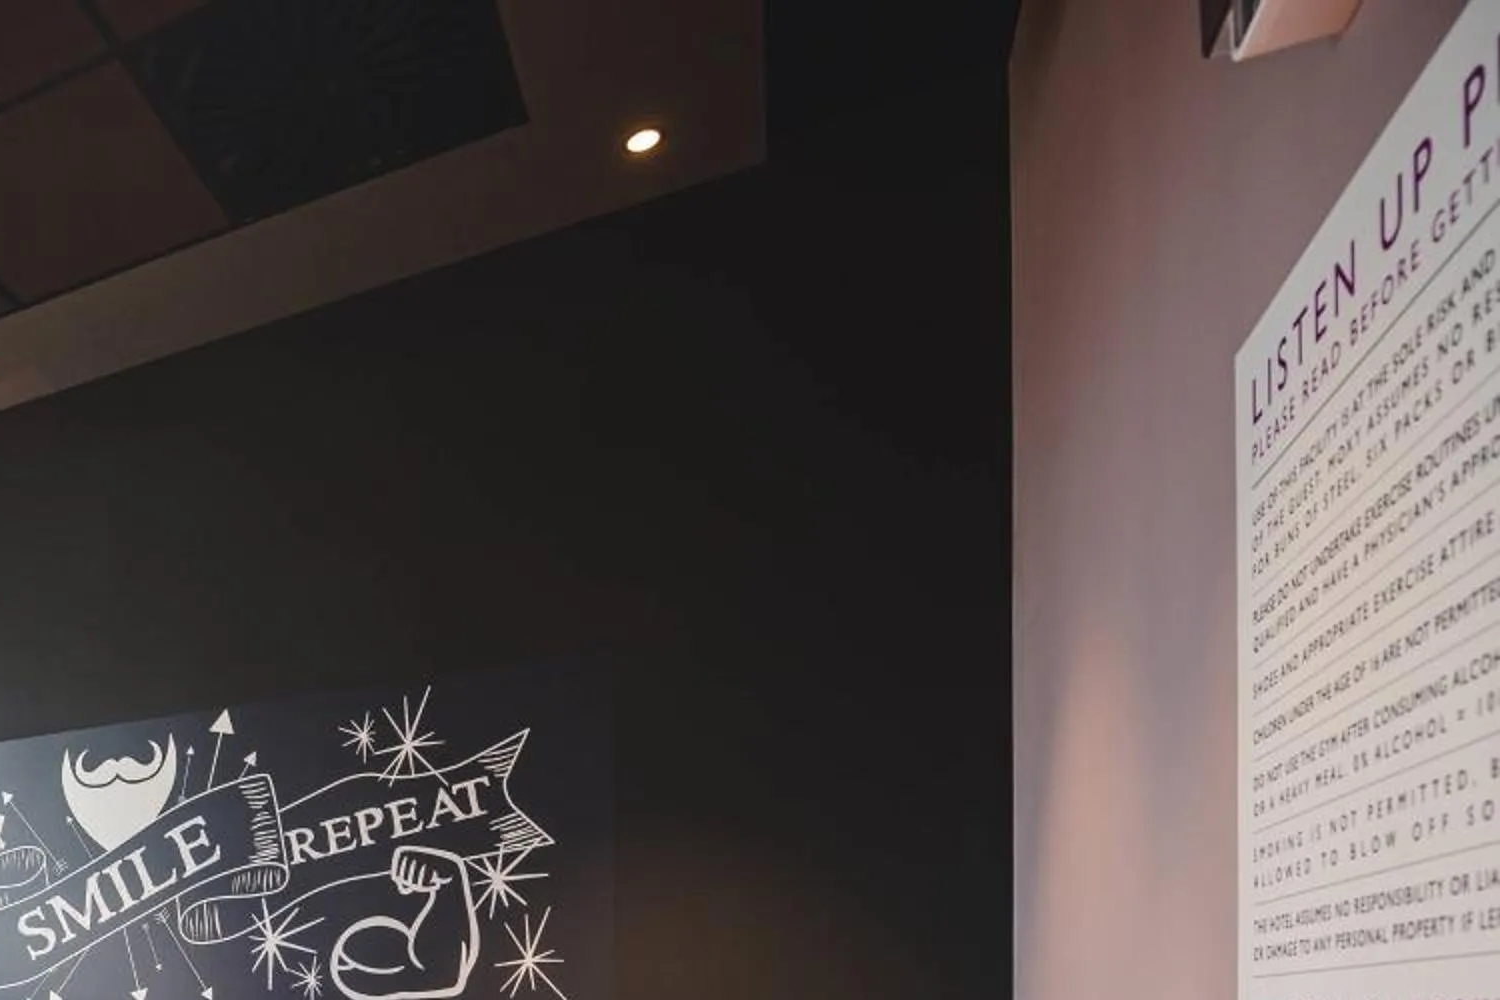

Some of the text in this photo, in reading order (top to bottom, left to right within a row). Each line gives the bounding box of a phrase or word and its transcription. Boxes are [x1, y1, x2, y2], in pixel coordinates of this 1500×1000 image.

[1252, 239, 1356, 425] LISTEN
[1380, 137, 1432, 251] UP
[1392, 326, 1422, 374] SOLE
[1427, 294, 1455, 332] RISK
[1462, 248, 1495, 294] AND
[1251, 396, 1294, 465] PLEASE
[1302, 340, 1340, 399] READ
[1350, 239, 1420, 346] BEFORE
[1437, 322, 1463, 355] NO
[1395, 380, 1442, 437] PACKS
[1452, 348, 1475, 385] OR
[1415, 411, 1480, 479] ROUTINES
[1440, 510, 1494, 563] ATTIRE
[1405, 620, 1430, 648] NOT
[290, 776, 492, 866] REPEAT
[1411, 812, 1449, 842] OFF
[1467, 799, 1494, 827] SO
[17, 816, 222, 960] SMILE
[1450, 873, 1469, 896] OR
[1392, 915, 1454, 940] PROPERTY
[1461, 911, 1473, 930] IF
